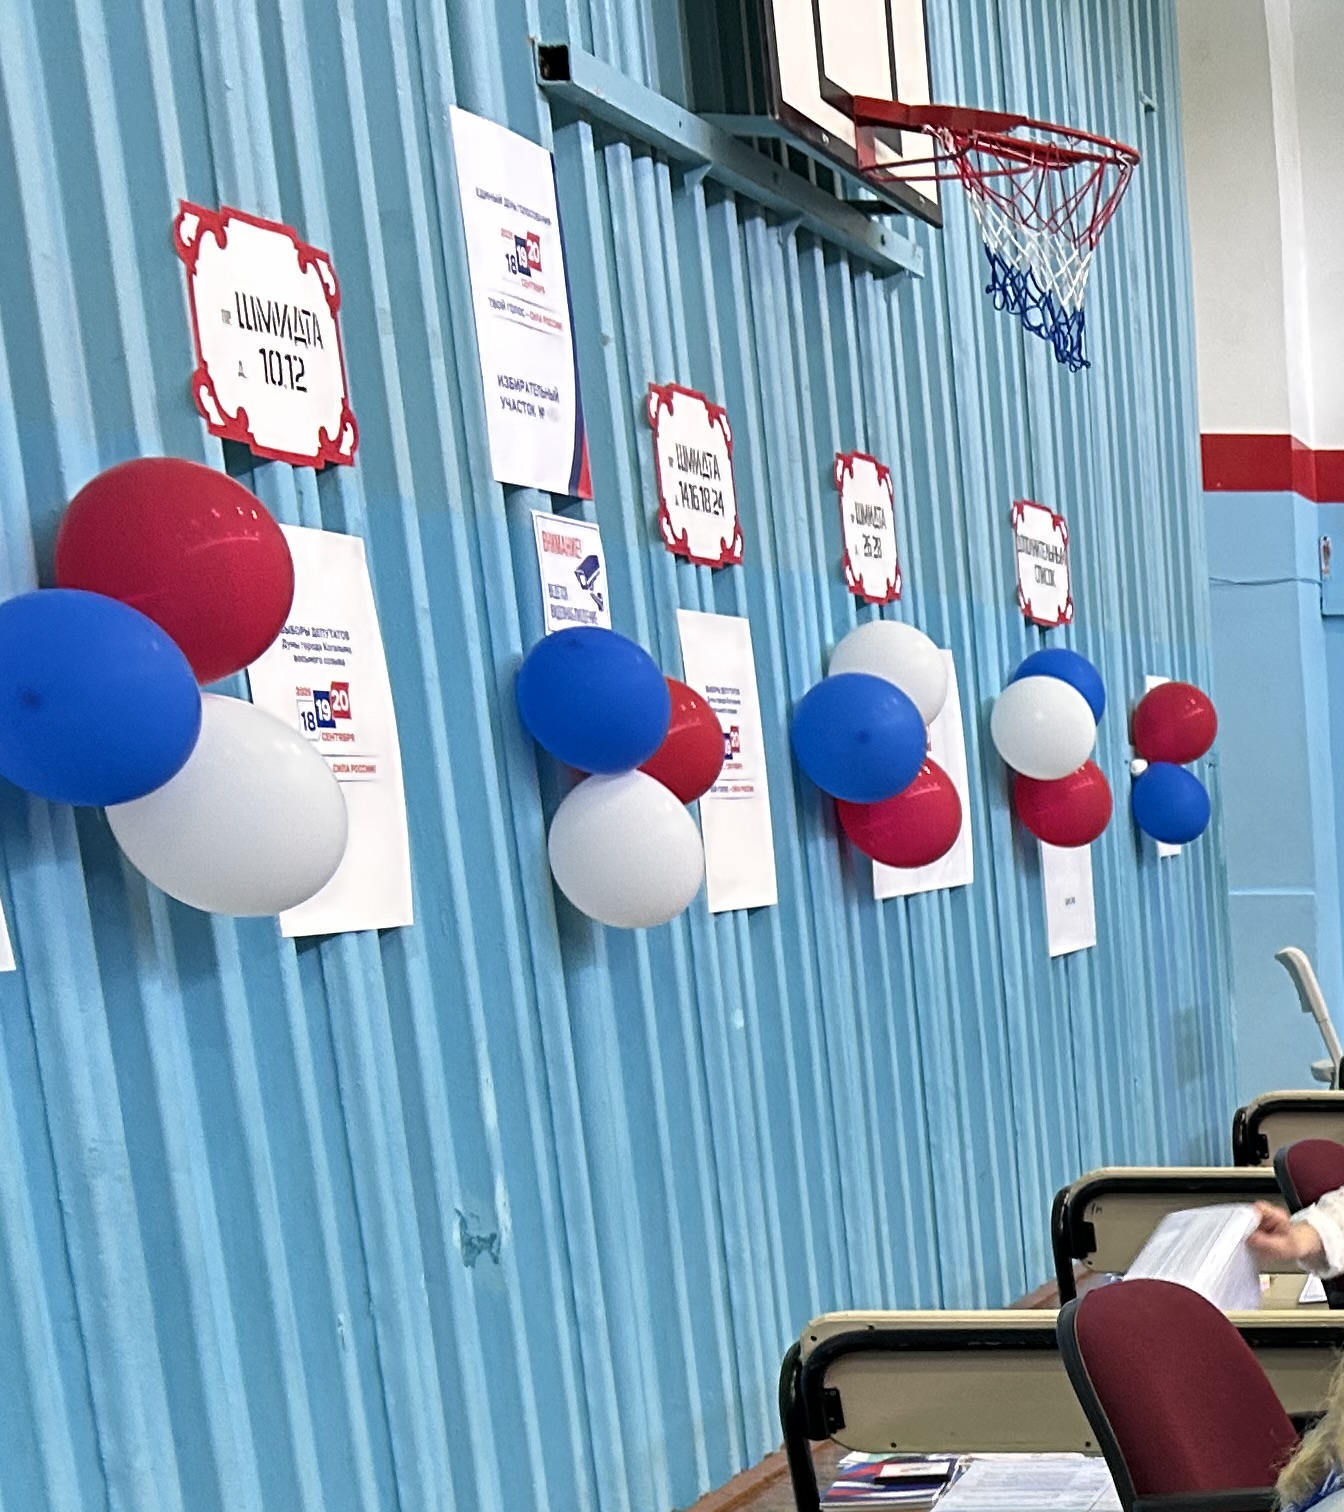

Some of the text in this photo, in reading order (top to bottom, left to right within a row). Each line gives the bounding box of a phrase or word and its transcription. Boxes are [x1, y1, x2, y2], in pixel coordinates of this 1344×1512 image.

[505, 239, 540, 275] 18 19 20
[235, 291, 324, 350] ШМИДТА
[497, 374, 559, 403] ИЗБИРАТЕЛЬНЫЙ
[500, 396, 537, 417] УЧАСТОК
[675, 442, 721, 481] ШМИДТА
[301, 689, 349, 732] 18 19 20
